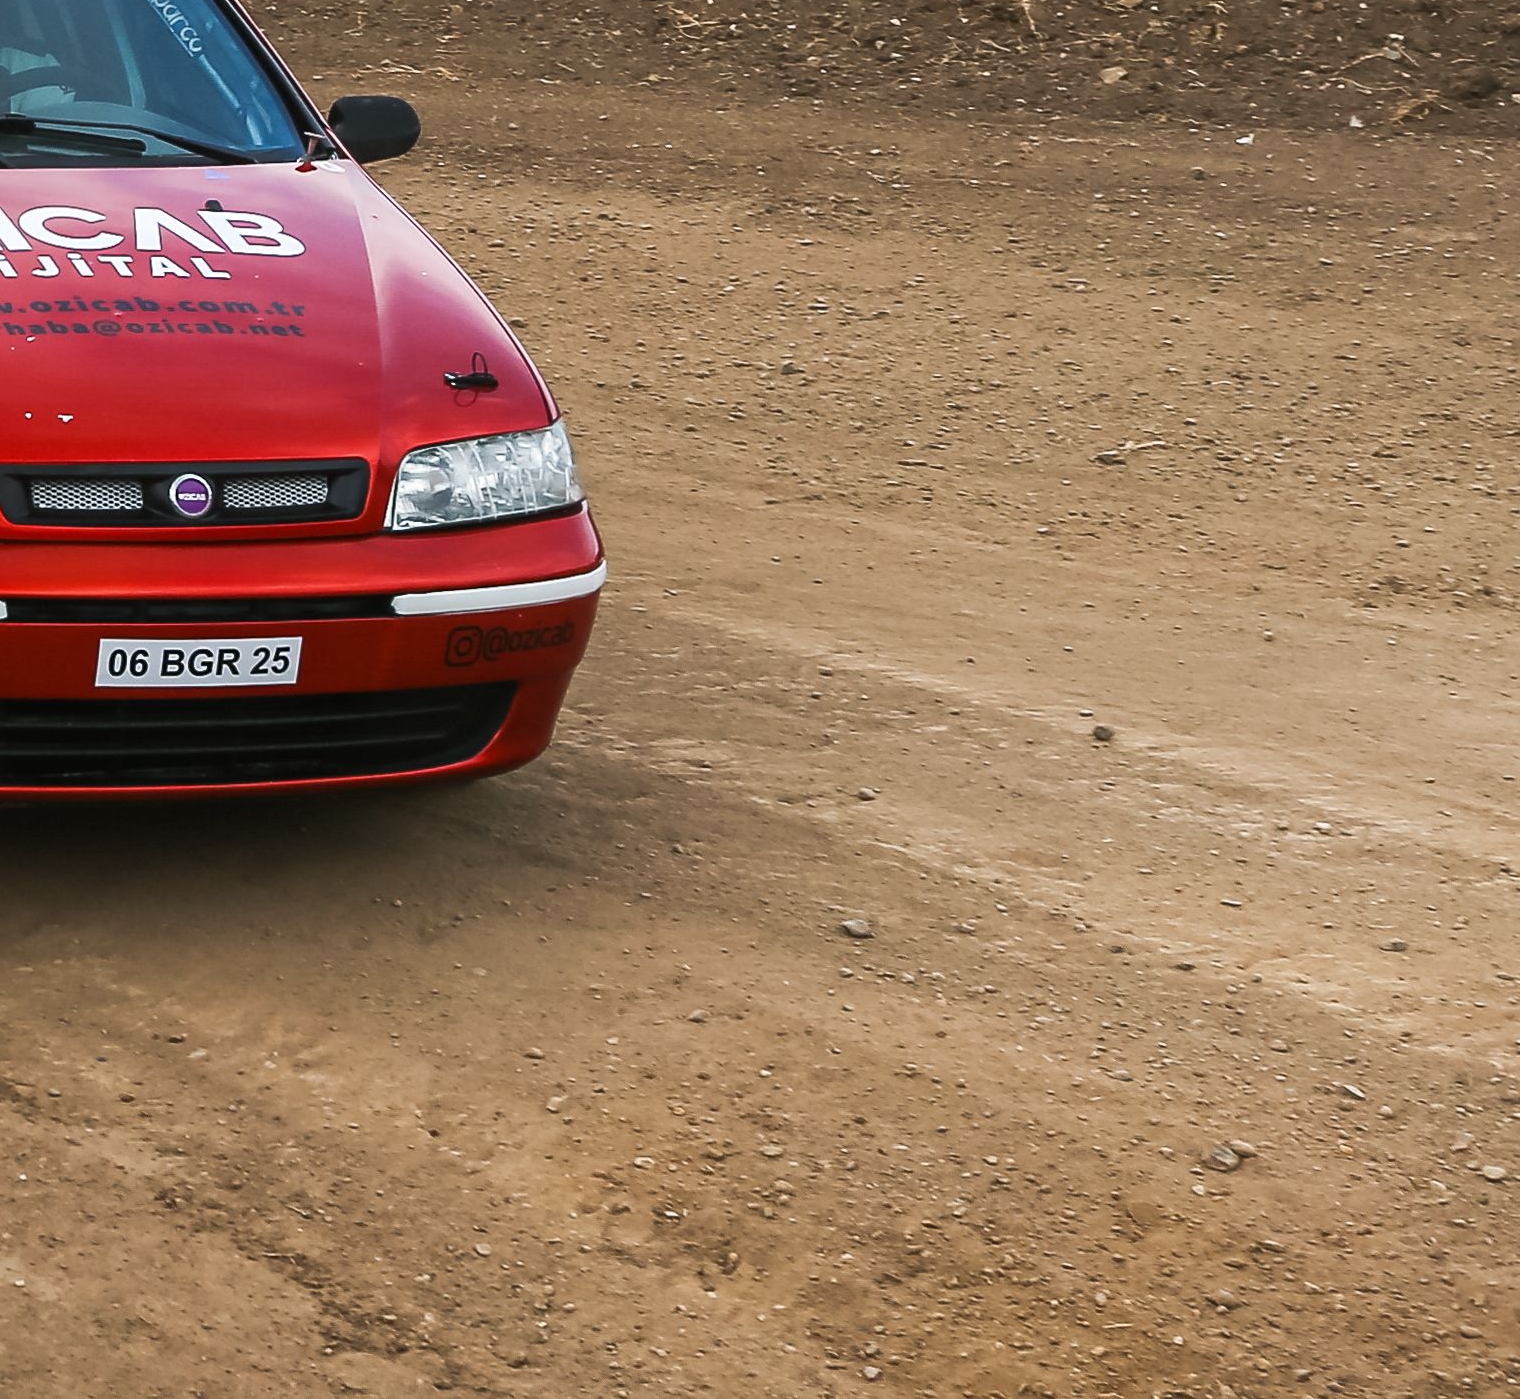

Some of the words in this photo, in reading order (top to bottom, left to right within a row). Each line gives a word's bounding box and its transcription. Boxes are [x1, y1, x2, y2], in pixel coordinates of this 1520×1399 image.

[108, 648, 150, 677] 06
[160, 648, 241, 677] BGR
[249, 646, 291, 675] 25
